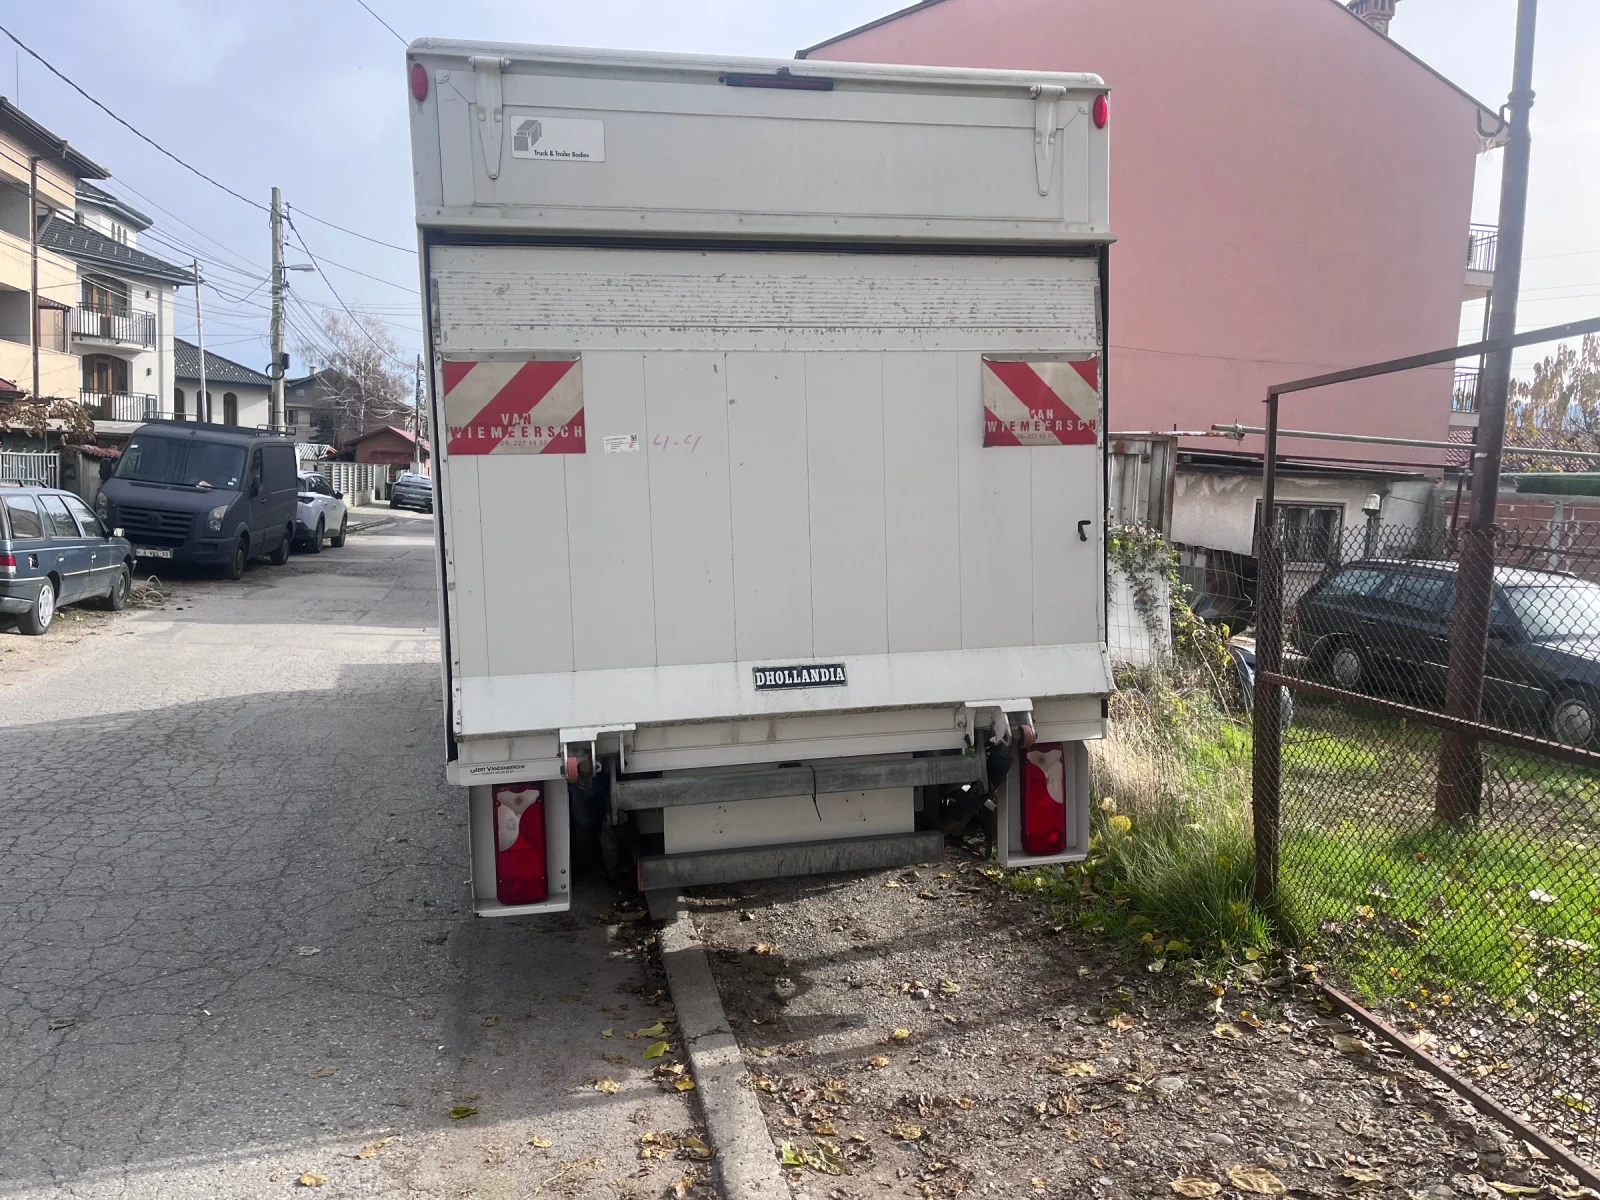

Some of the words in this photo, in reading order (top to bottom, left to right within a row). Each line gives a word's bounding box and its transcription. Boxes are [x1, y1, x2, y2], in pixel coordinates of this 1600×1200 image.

[501, 413, 532, 425] VAN
[1029, 408, 1054, 420] VAN
[449, 425, 583, 439] WIEMEERSCH
[987, 419, 1096, 433] WIEMEERSCH
[755, 667, 845, 686] DHOLLANDIA
